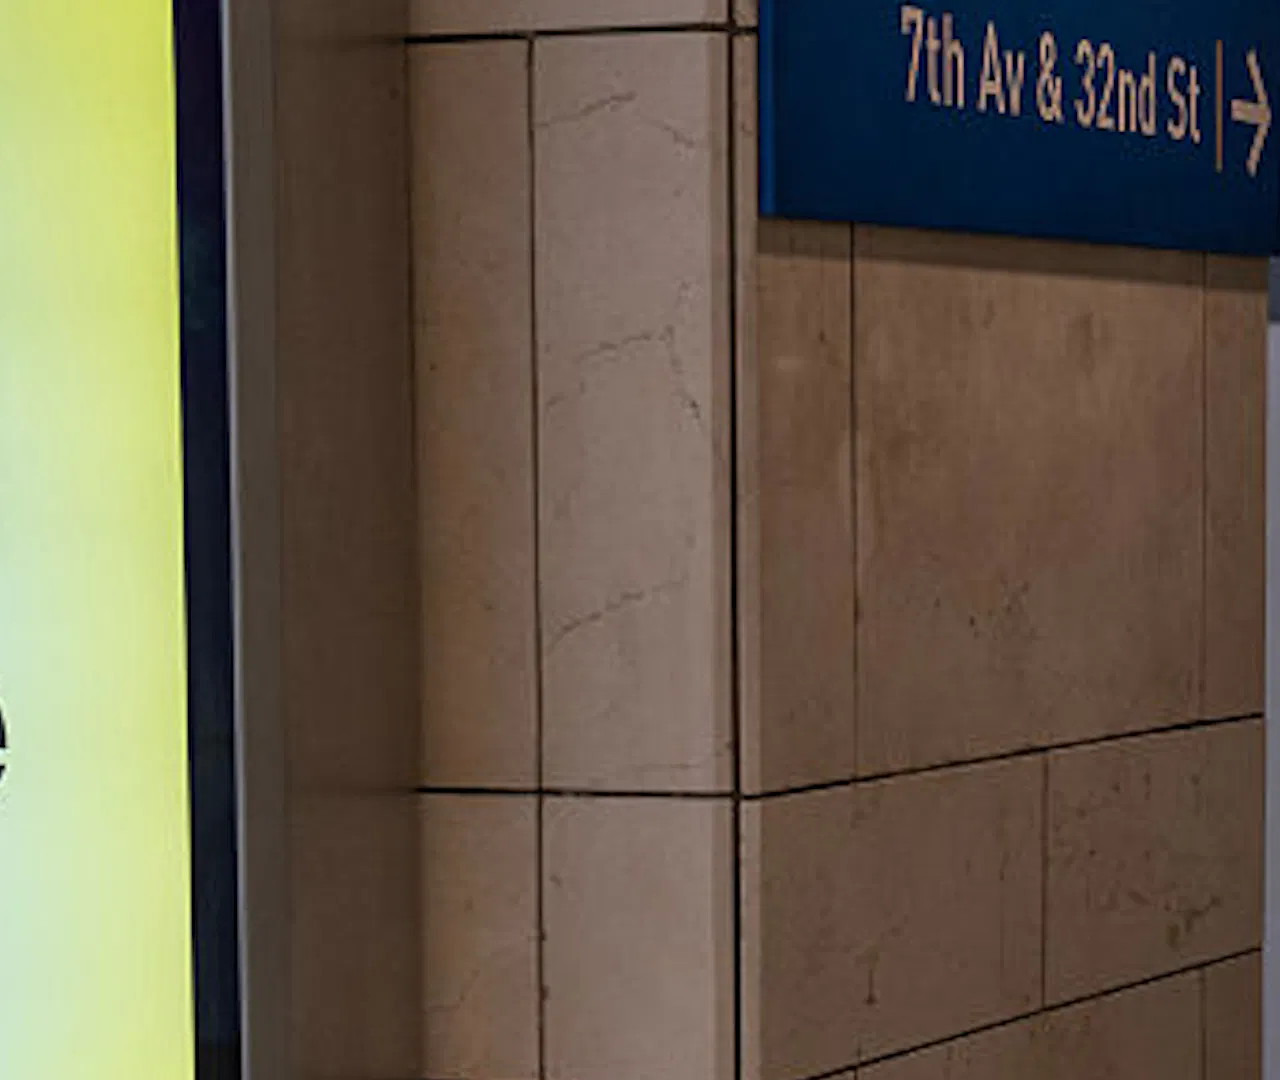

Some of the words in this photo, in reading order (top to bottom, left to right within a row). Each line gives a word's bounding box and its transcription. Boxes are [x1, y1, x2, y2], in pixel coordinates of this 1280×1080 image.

[900, 5, 965, 109] 7th
[977, 21, 1025, 117] Av
[1035, 31, 1064, 122] &
[1073, 38, 1157, 136] 32nd
[1166, 56, 1201, 144] St
